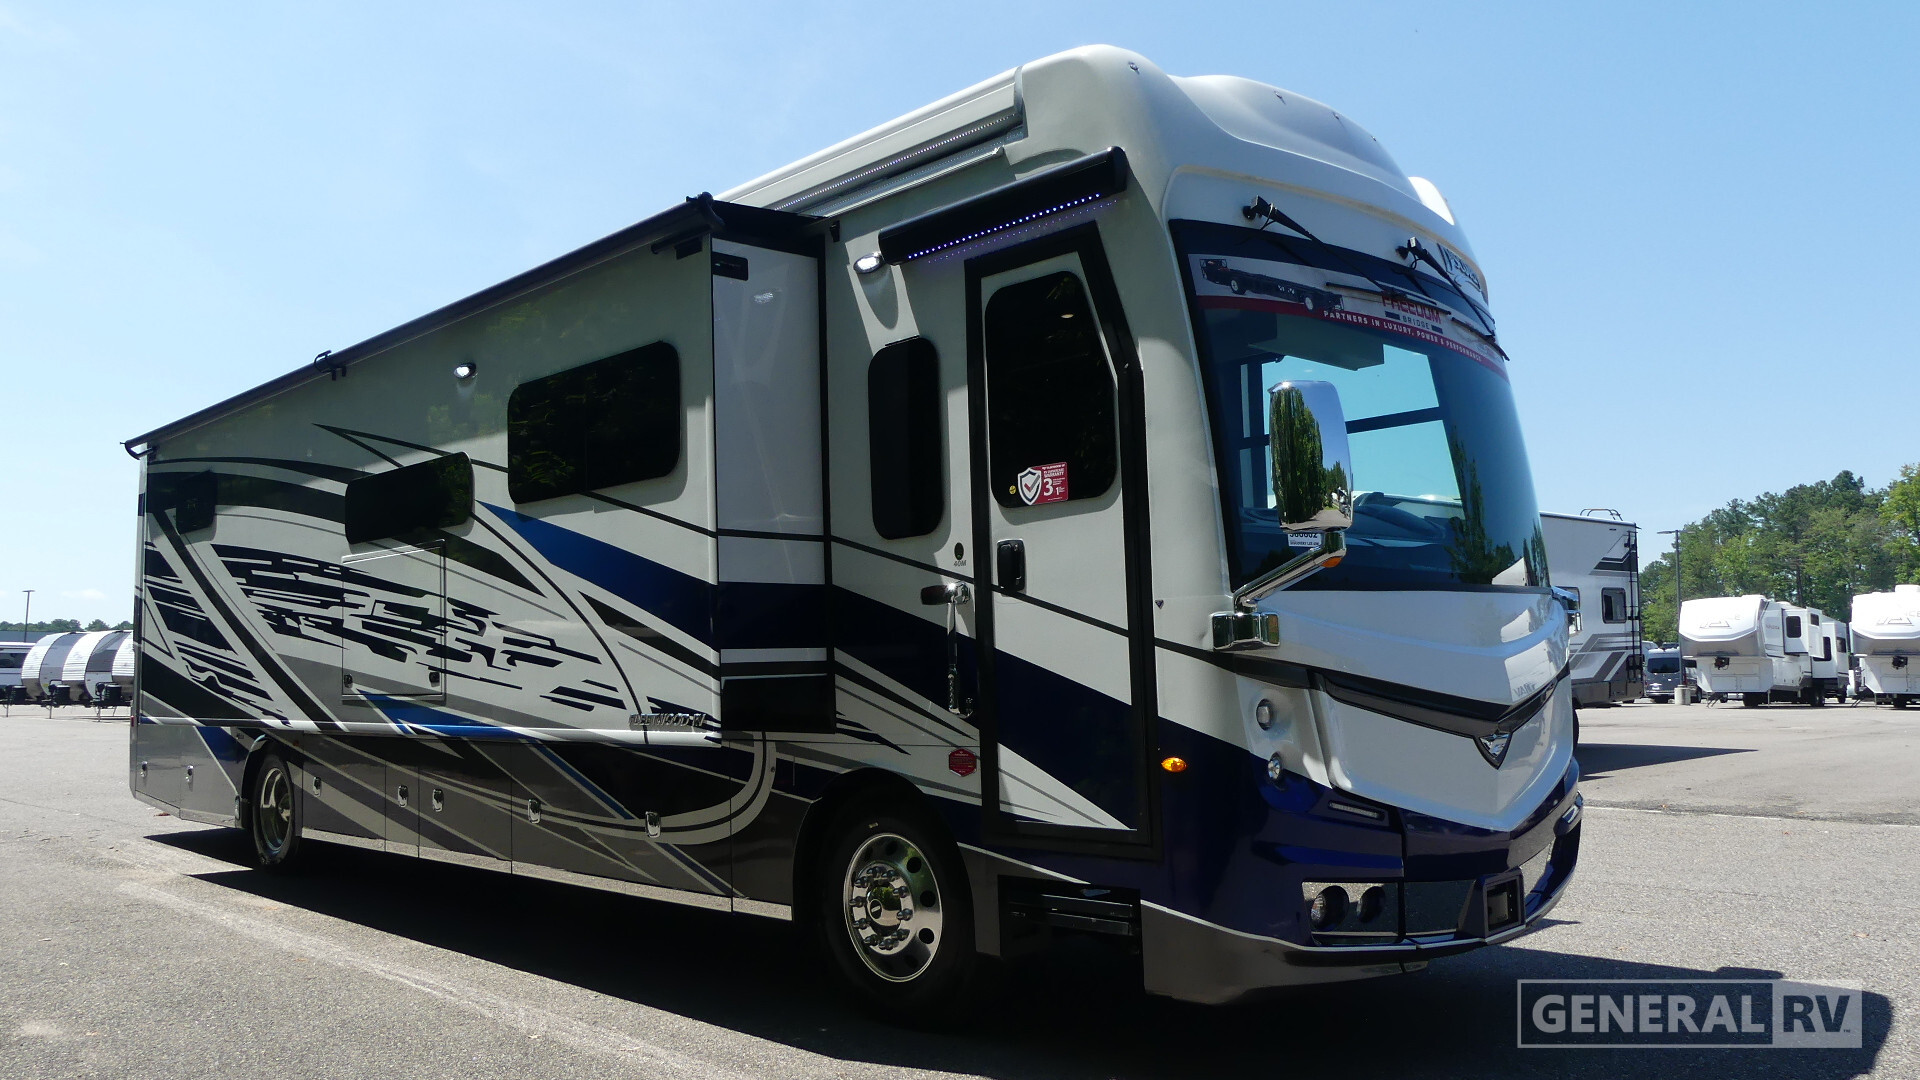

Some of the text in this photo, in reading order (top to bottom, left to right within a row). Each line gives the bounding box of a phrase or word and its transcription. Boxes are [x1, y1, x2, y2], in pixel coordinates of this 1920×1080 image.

[1402, 315, 1430, 329] BRIDGE
[1323, 310, 1368, 324] PARTNERS
[1371, 319, 1380, 327] IN
[1416, 330, 1438, 342] POWER
[1446, 340, 1482, 362] PERFORMANCE
[1043, 478, 1053, 496] 3
